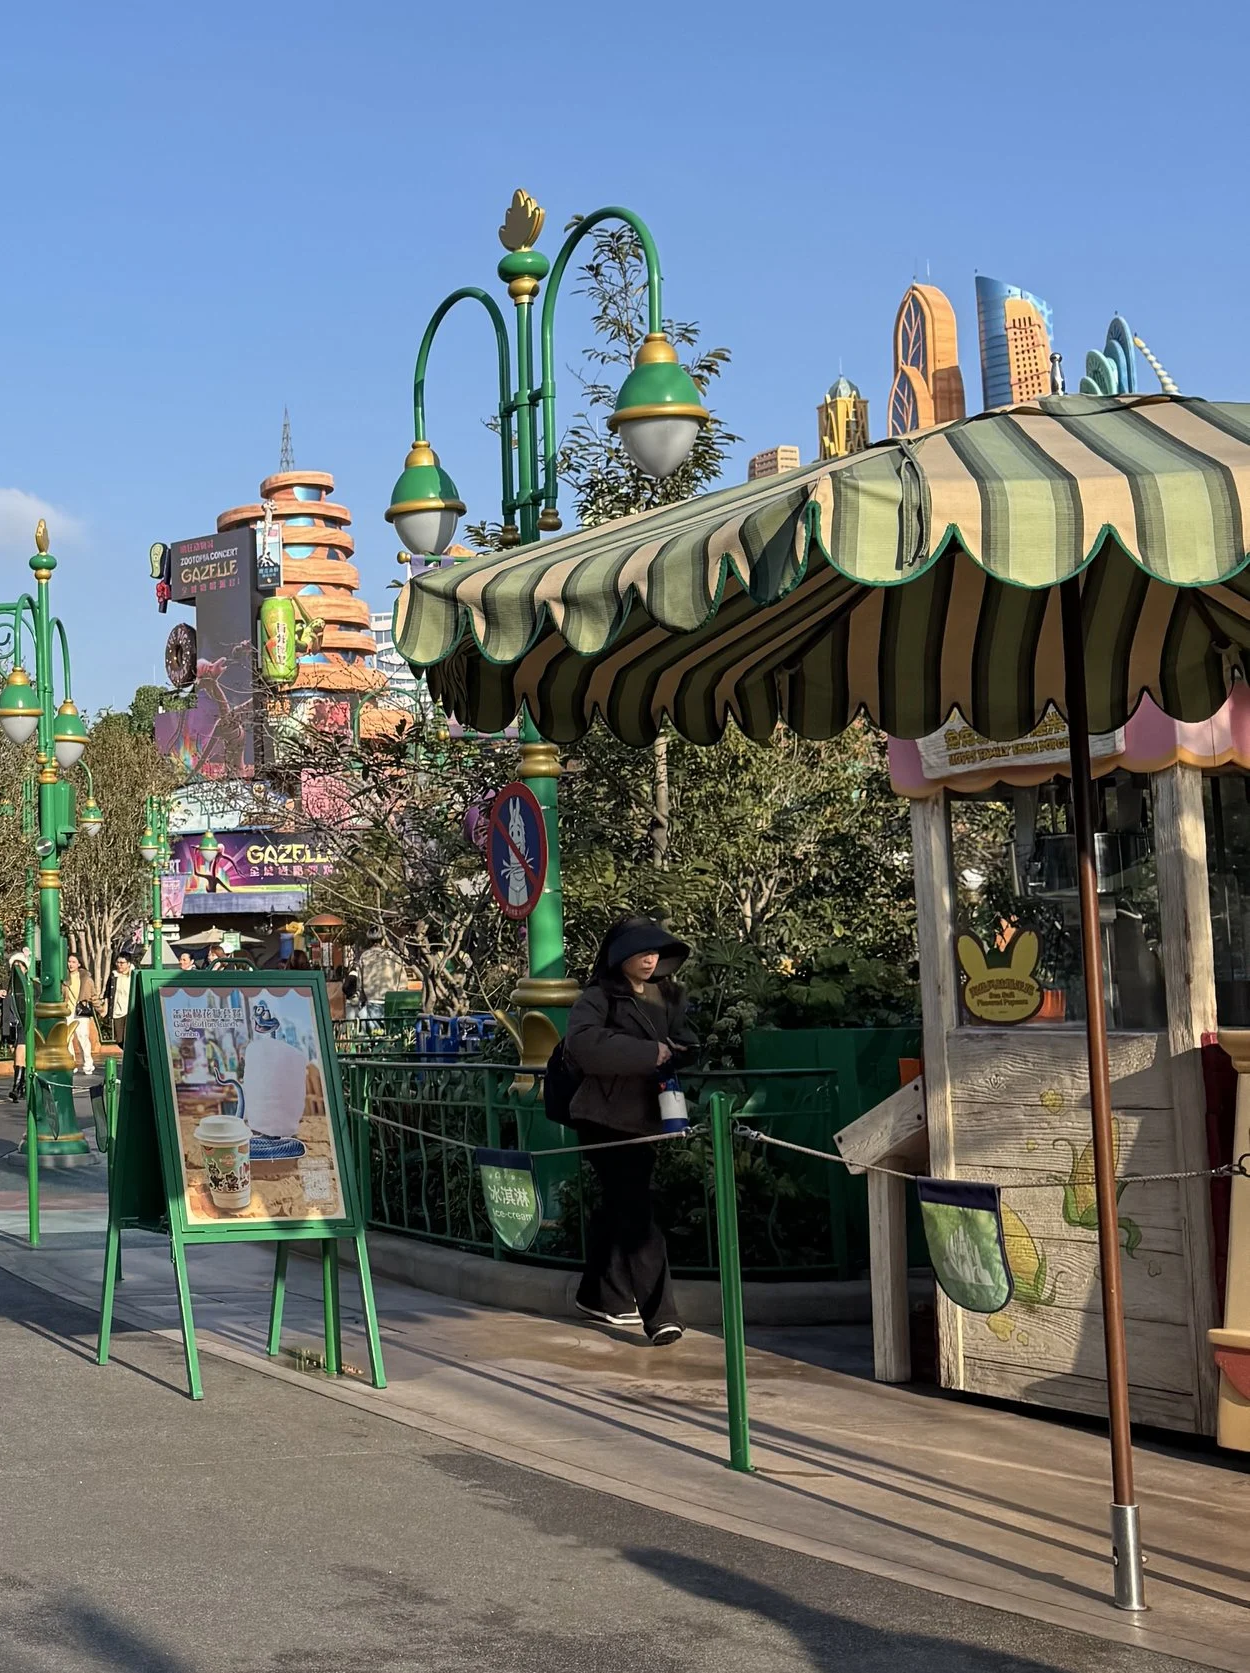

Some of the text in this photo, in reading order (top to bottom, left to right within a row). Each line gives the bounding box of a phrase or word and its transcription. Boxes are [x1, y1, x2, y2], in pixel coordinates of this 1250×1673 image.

[180, 547, 239, 567] ZOOTOPIA CONCERT
[181, 559, 239, 584] GAZELLE
[977, 745, 1011, 762] FAMILY
[1011, 740, 1039, 755] FARM
[1039, 737, 1070, 752] POPCO
[488, 1184, 530, 1207] 冰淇淋
